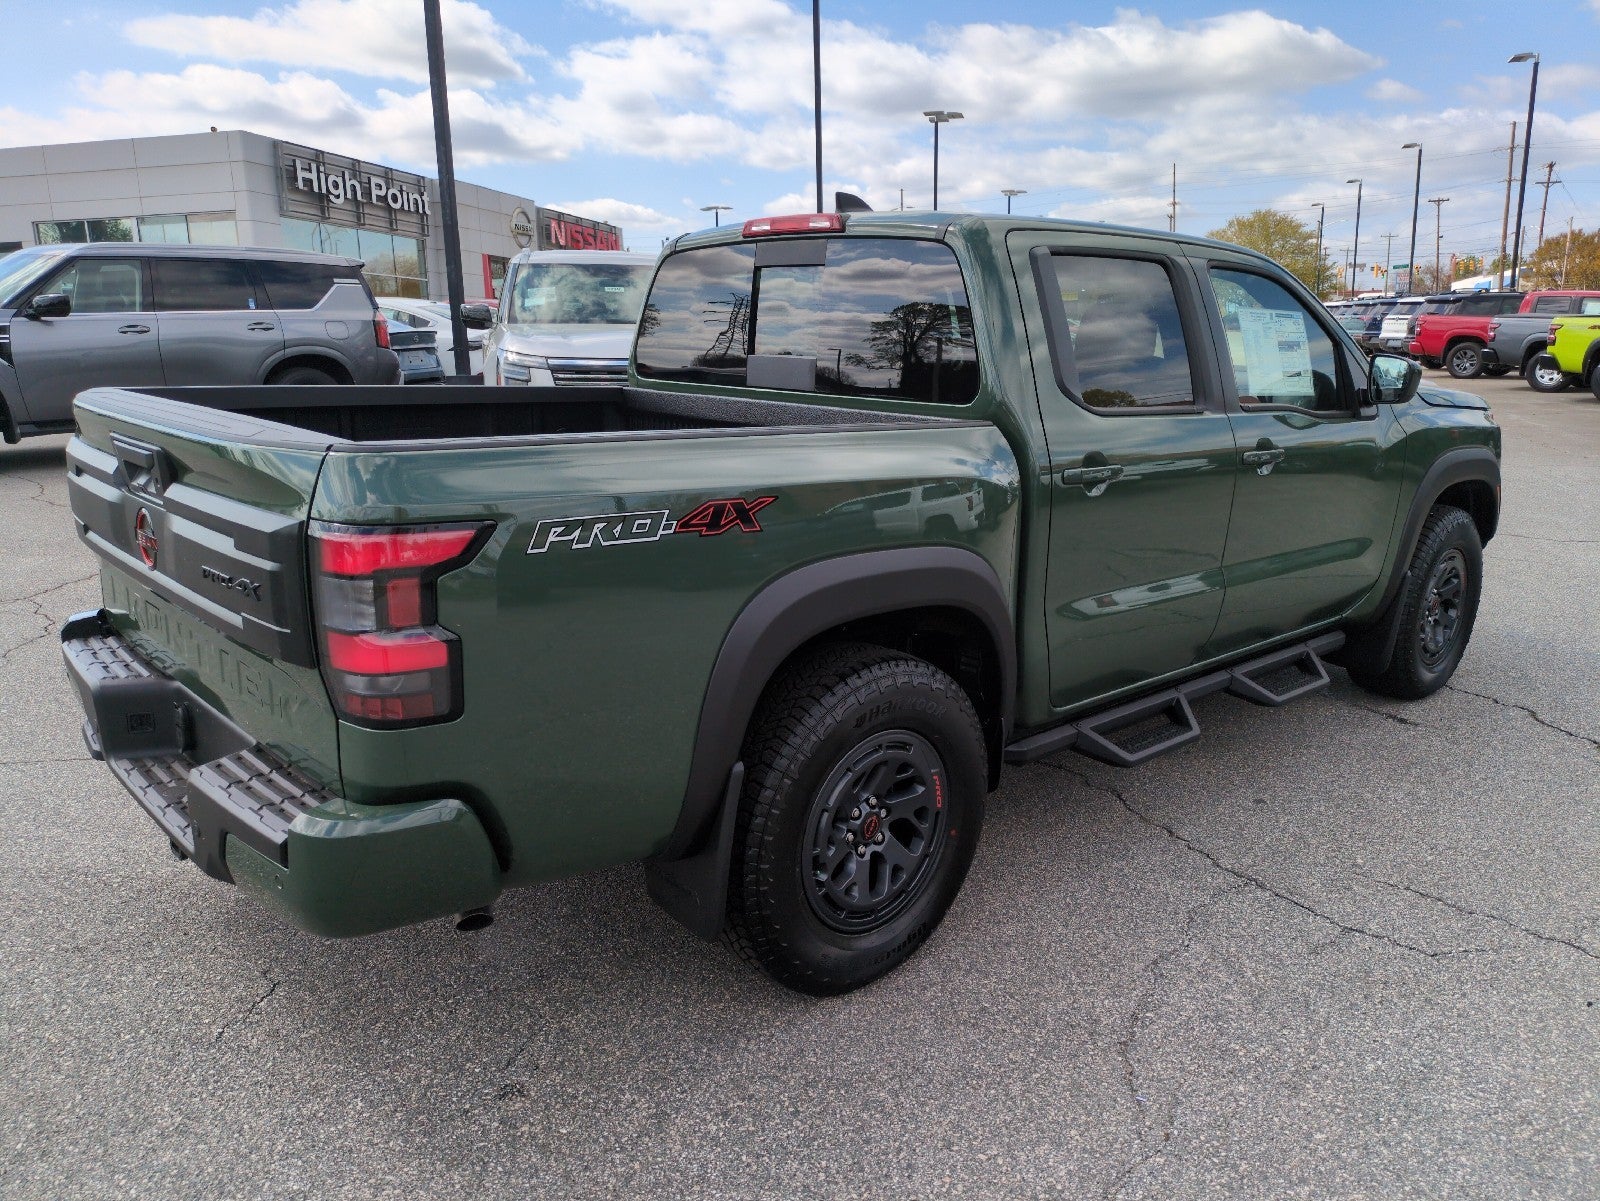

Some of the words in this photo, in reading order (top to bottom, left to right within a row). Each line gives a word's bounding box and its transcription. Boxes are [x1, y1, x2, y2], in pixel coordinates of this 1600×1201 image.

[294, 158, 363, 205] High
[369, 176, 432, 216] Point
[550, 219, 620, 251] NISSAN
[525, 496, 778, 554] PRO-4X
